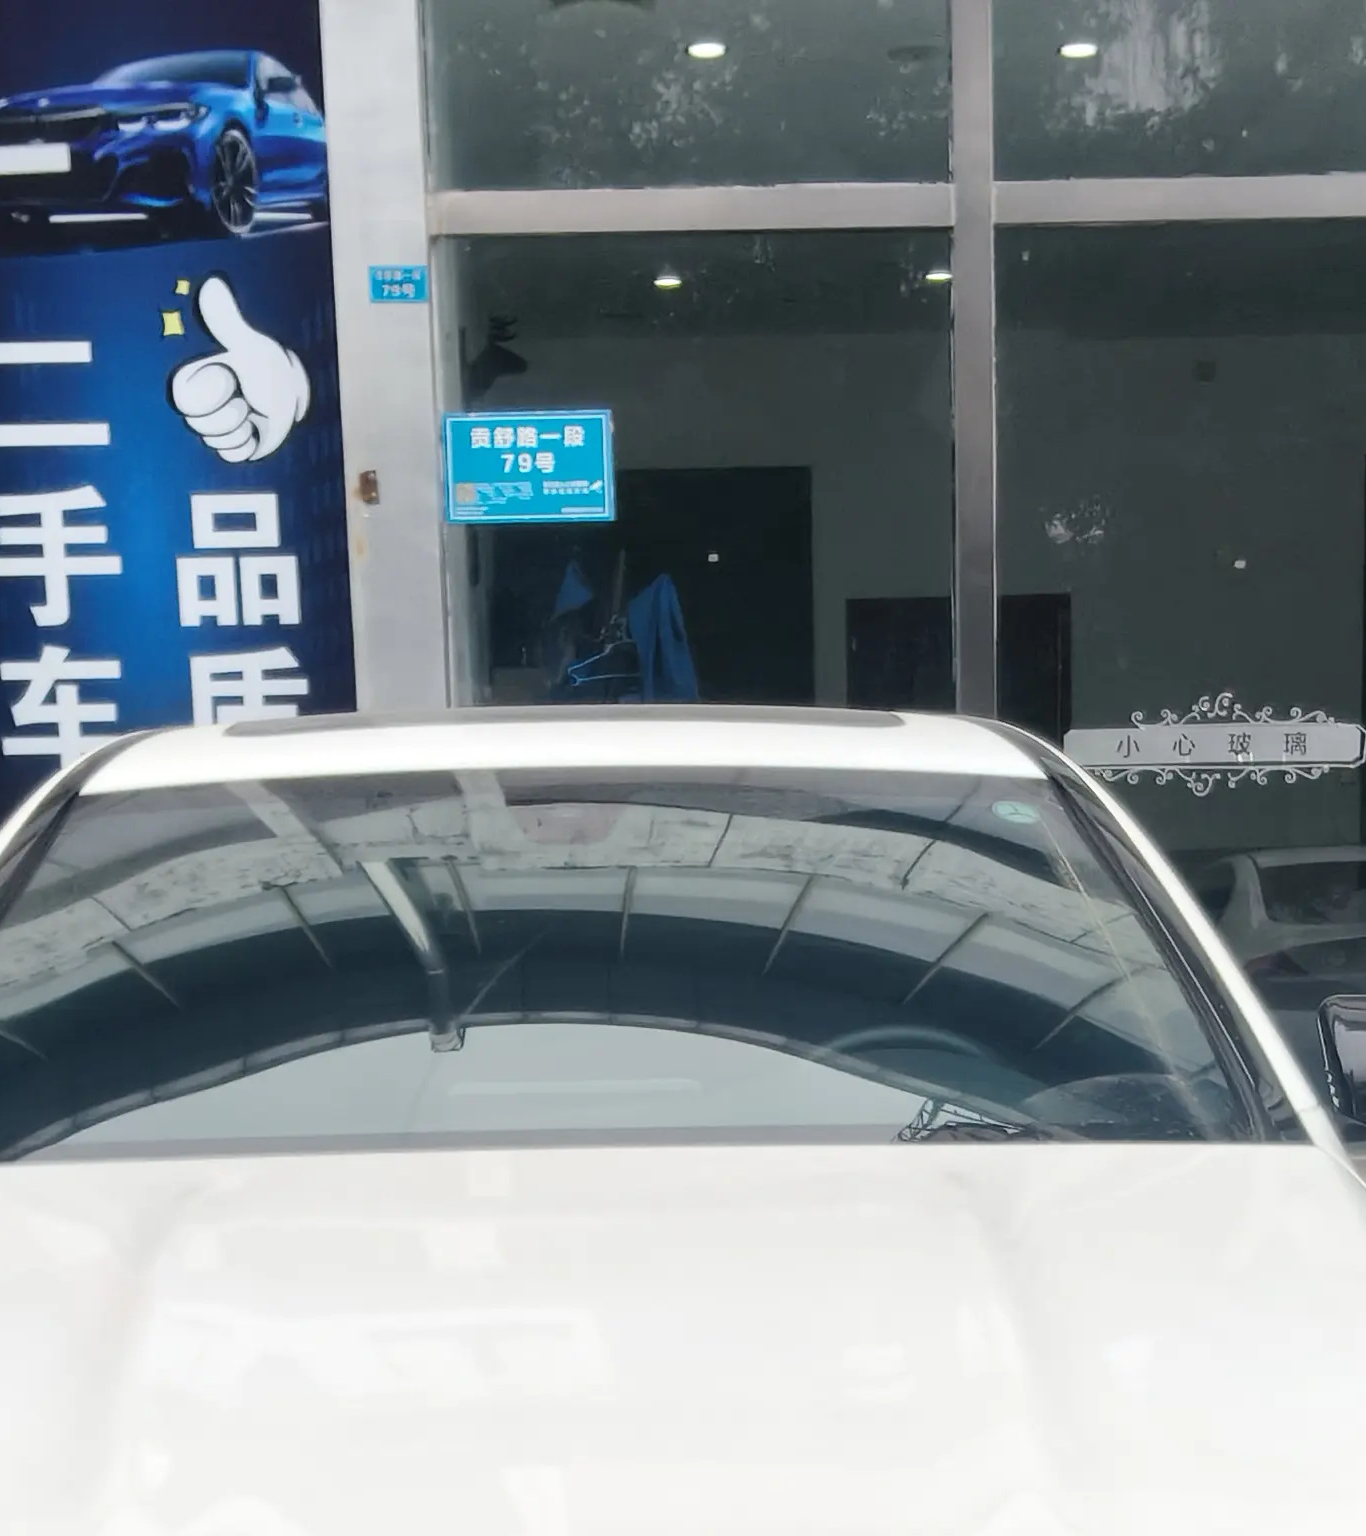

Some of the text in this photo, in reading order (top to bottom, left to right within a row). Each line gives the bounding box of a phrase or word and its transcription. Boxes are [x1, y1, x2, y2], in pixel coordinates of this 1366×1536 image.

[501, 451, 555, 473] 79号
[1116, 732, 1308, 758] 小心玻璃
